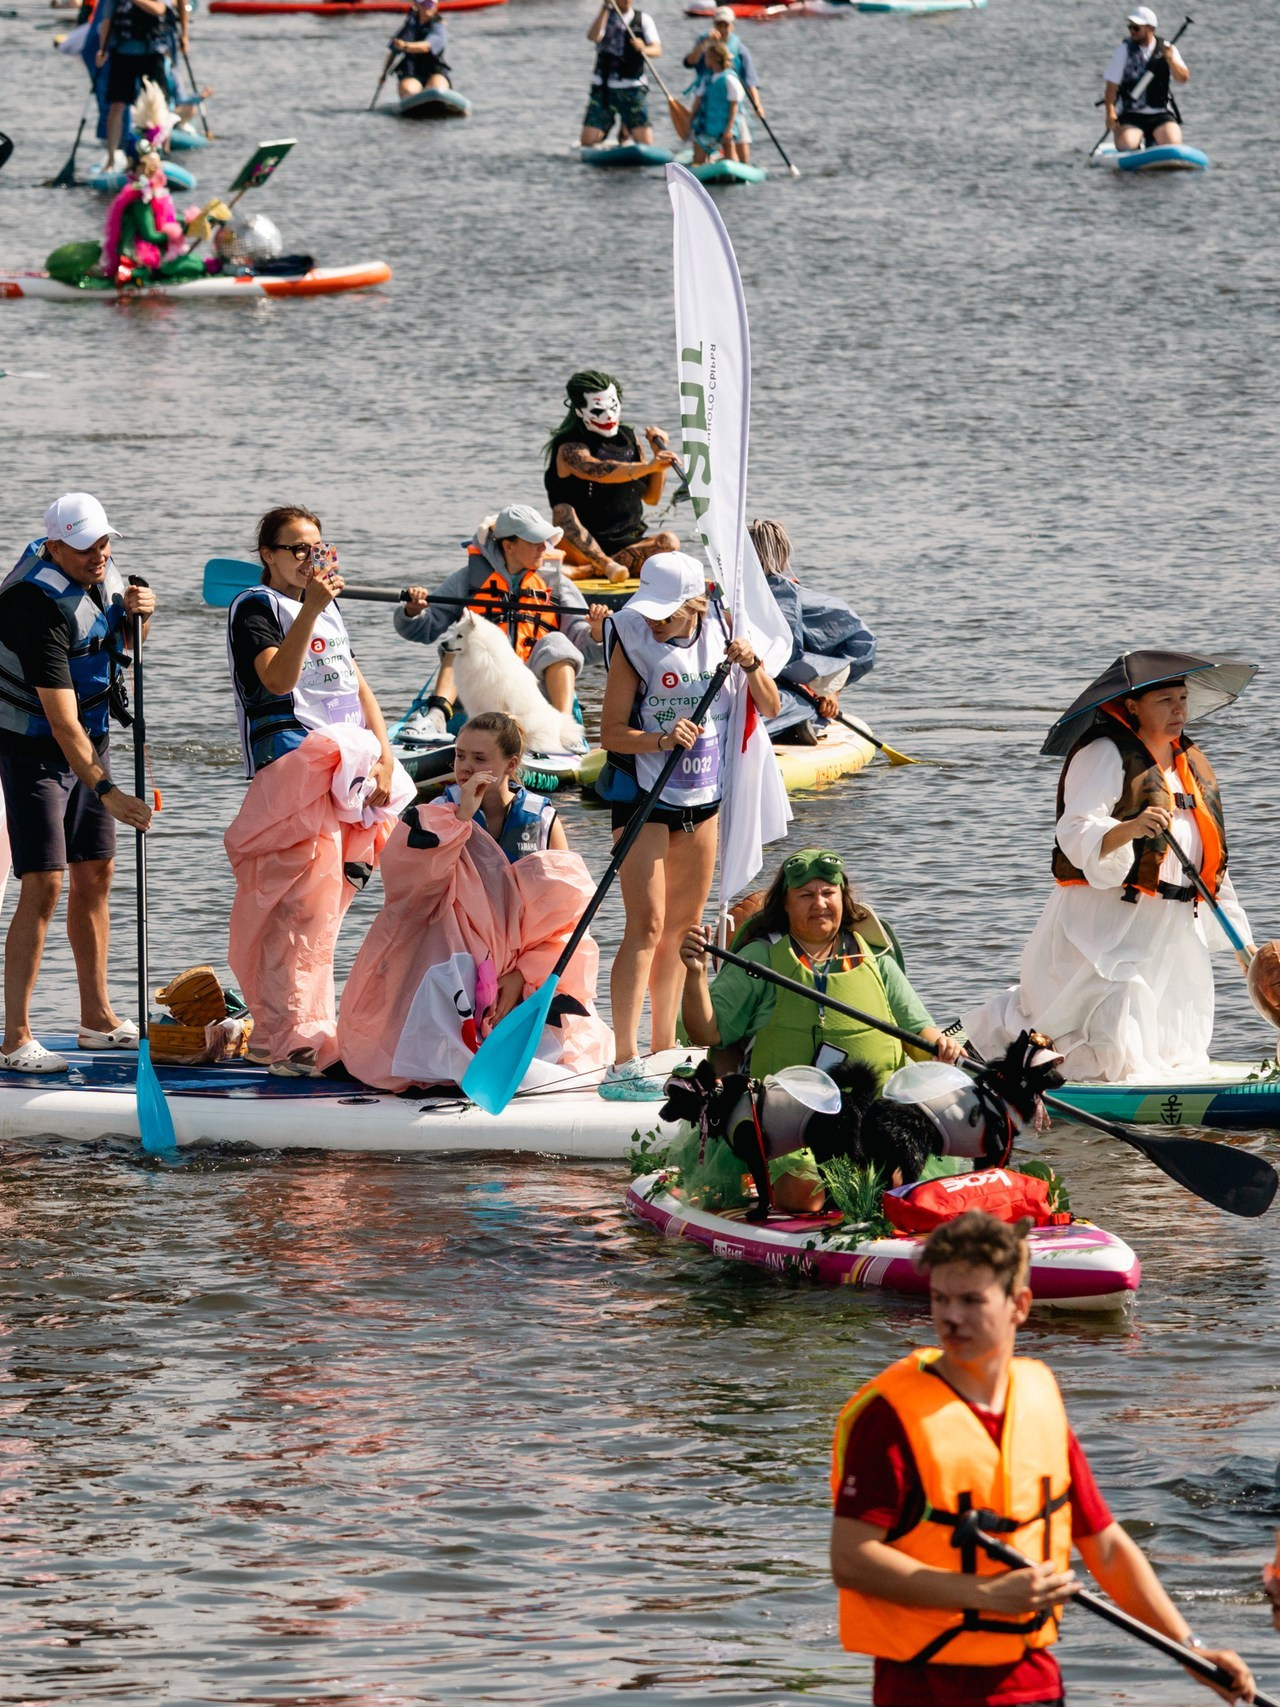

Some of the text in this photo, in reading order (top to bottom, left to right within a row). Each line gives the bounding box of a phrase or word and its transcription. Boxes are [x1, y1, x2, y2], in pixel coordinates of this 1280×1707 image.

[316, 654, 343, 667] поля
[323, 672, 339, 684] до
[648, 695, 666, 707] От
[682, 755, 712, 775] 0032
[516, 841, 538, 852] YAMAHA
